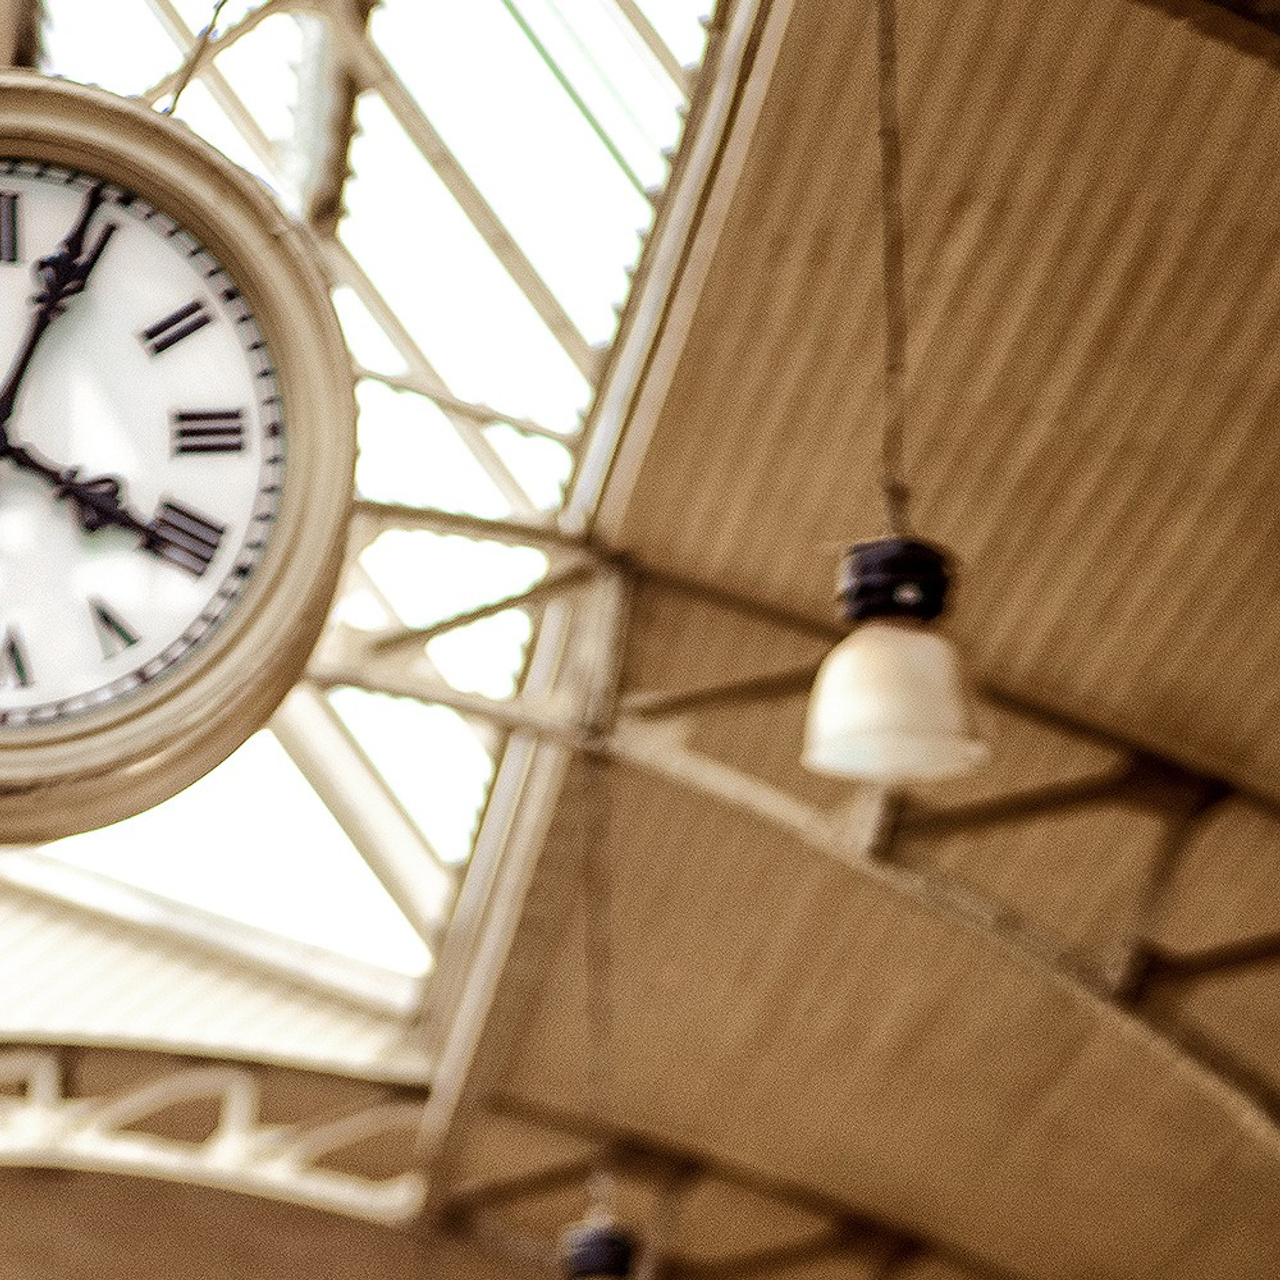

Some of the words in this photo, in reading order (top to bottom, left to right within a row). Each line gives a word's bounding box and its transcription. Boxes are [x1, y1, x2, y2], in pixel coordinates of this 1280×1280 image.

[139, 300, 212, 355] II
[172, 408, 244, 456] III
[85, 598, 139, 660] V
